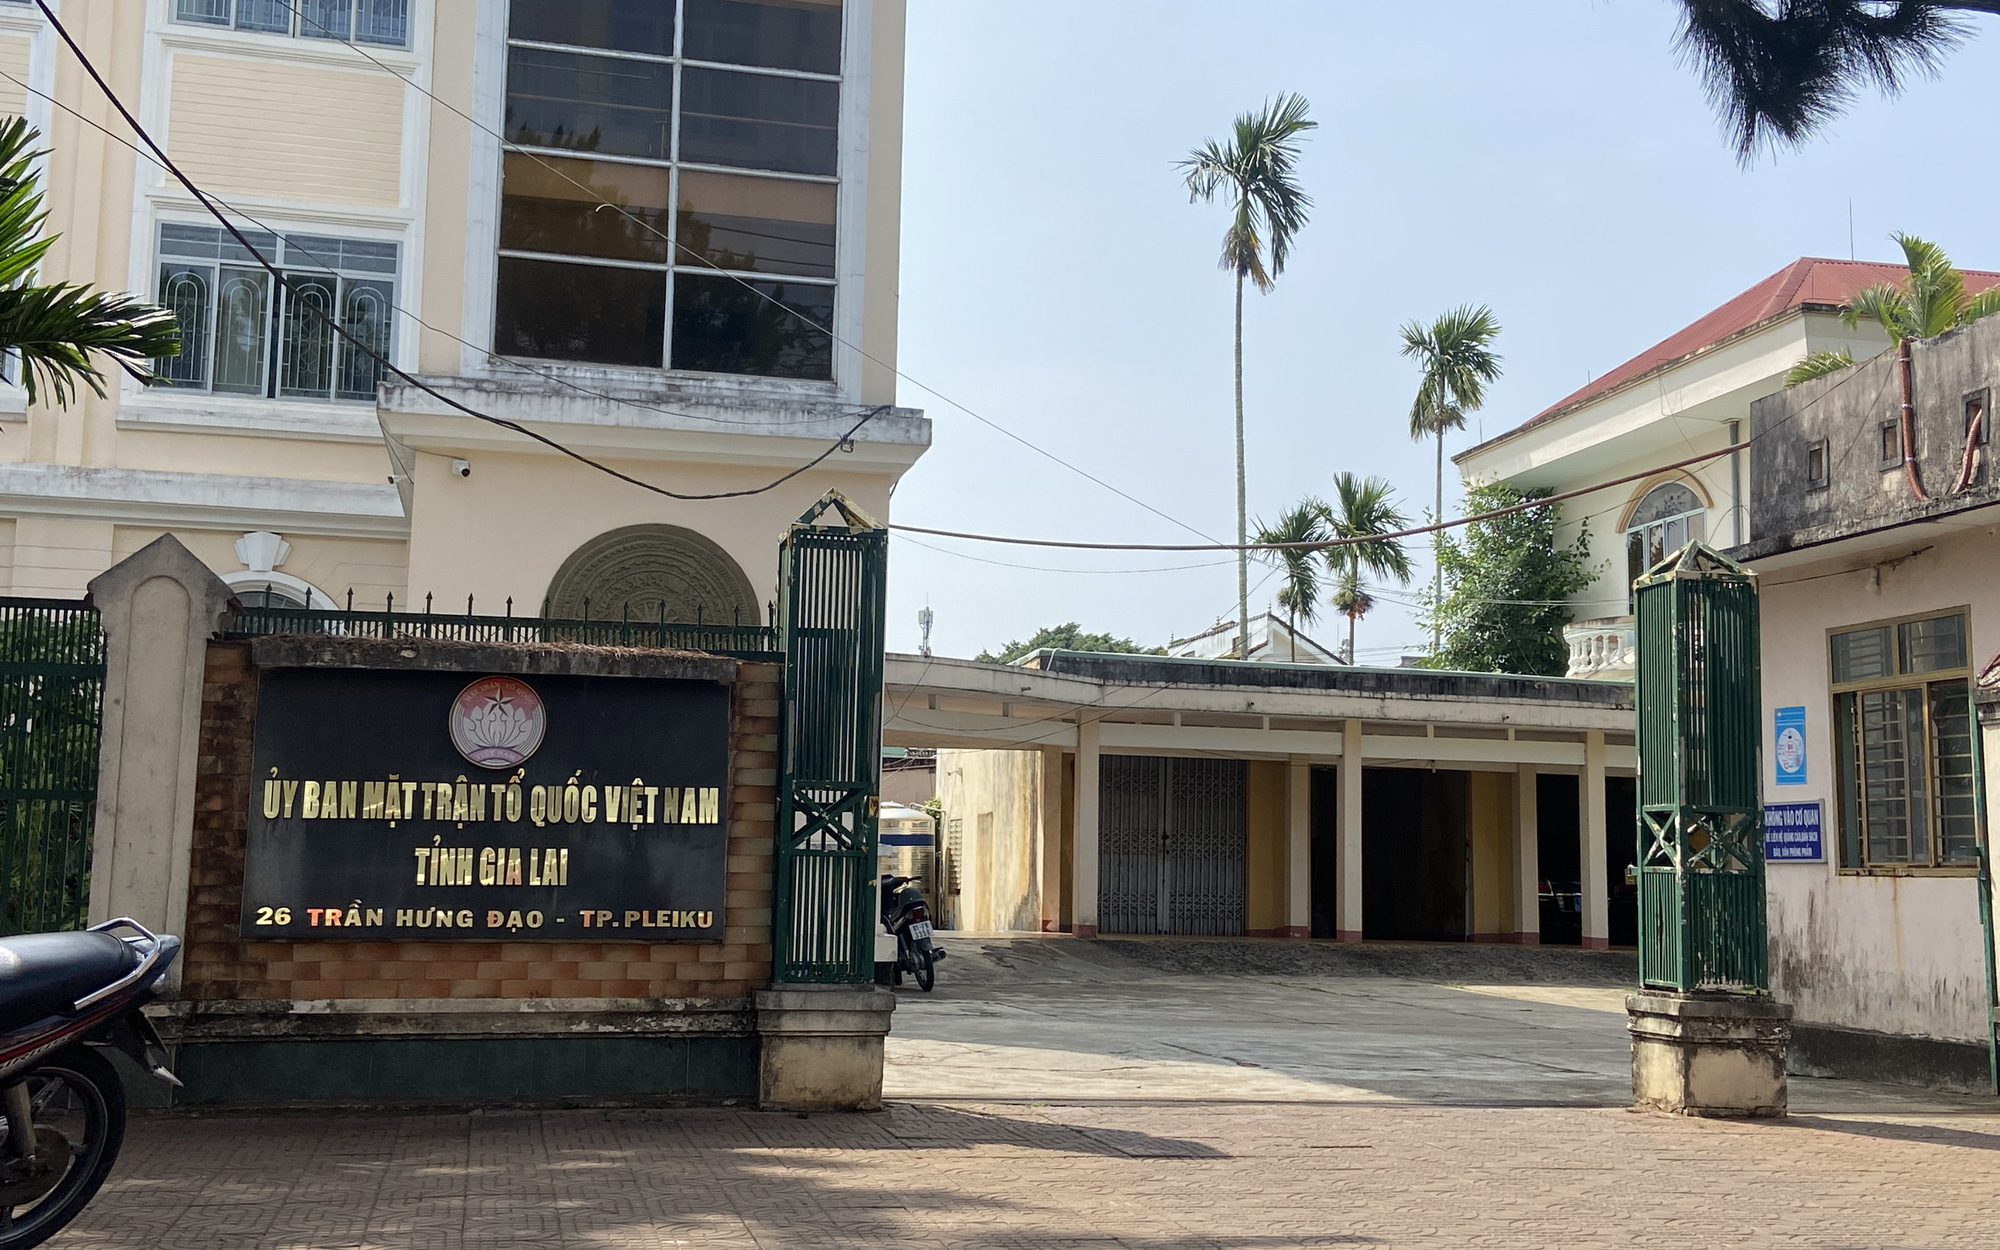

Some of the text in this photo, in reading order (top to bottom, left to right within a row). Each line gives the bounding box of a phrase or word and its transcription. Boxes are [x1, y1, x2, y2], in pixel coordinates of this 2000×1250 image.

[263, 767, 719, 831] ỦY BAN MẶT TRẬN TỔ QUỐC VIỆT NAM
[1803, 809, 1819, 828] QUAN
[414, 835, 569, 886] TỈNH GIA LAI
[255, 906, 292, 926] 26
[306, 899, 384, 927] TRẦN
[396, 907, 474, 928] HƯNG
[485, 910, 544, 933] ĐẠO
